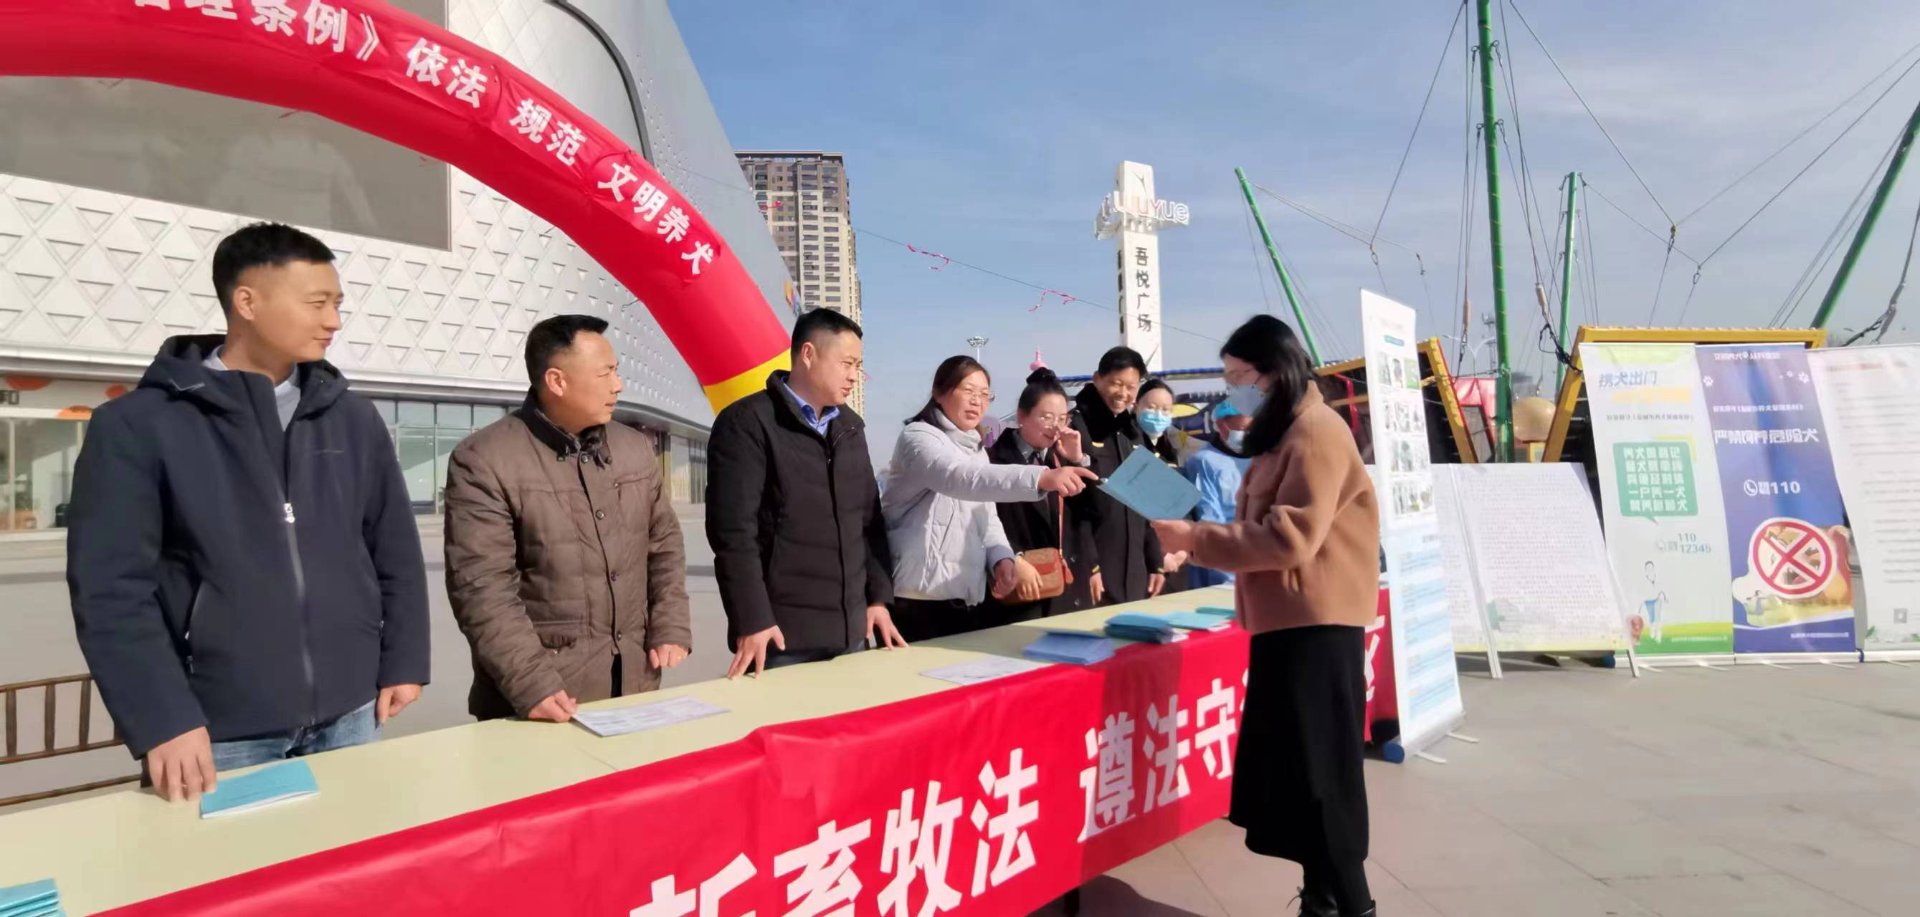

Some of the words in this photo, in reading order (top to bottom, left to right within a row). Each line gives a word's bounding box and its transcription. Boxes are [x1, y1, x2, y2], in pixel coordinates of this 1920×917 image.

[405, 37, 488, 108] 依法
[508, 97, 587, 166] 规范
[597, 161, 715, 275] 文明养犬
[1135, 247, 1151, 332] 吾悦广场
[1770, 481, 1801, 495] 110
[1678, 532, 1697, 542] 110
[1680, 543, 1712, 553] 12345
[1078, 668, 1247, 843] 遵法守
